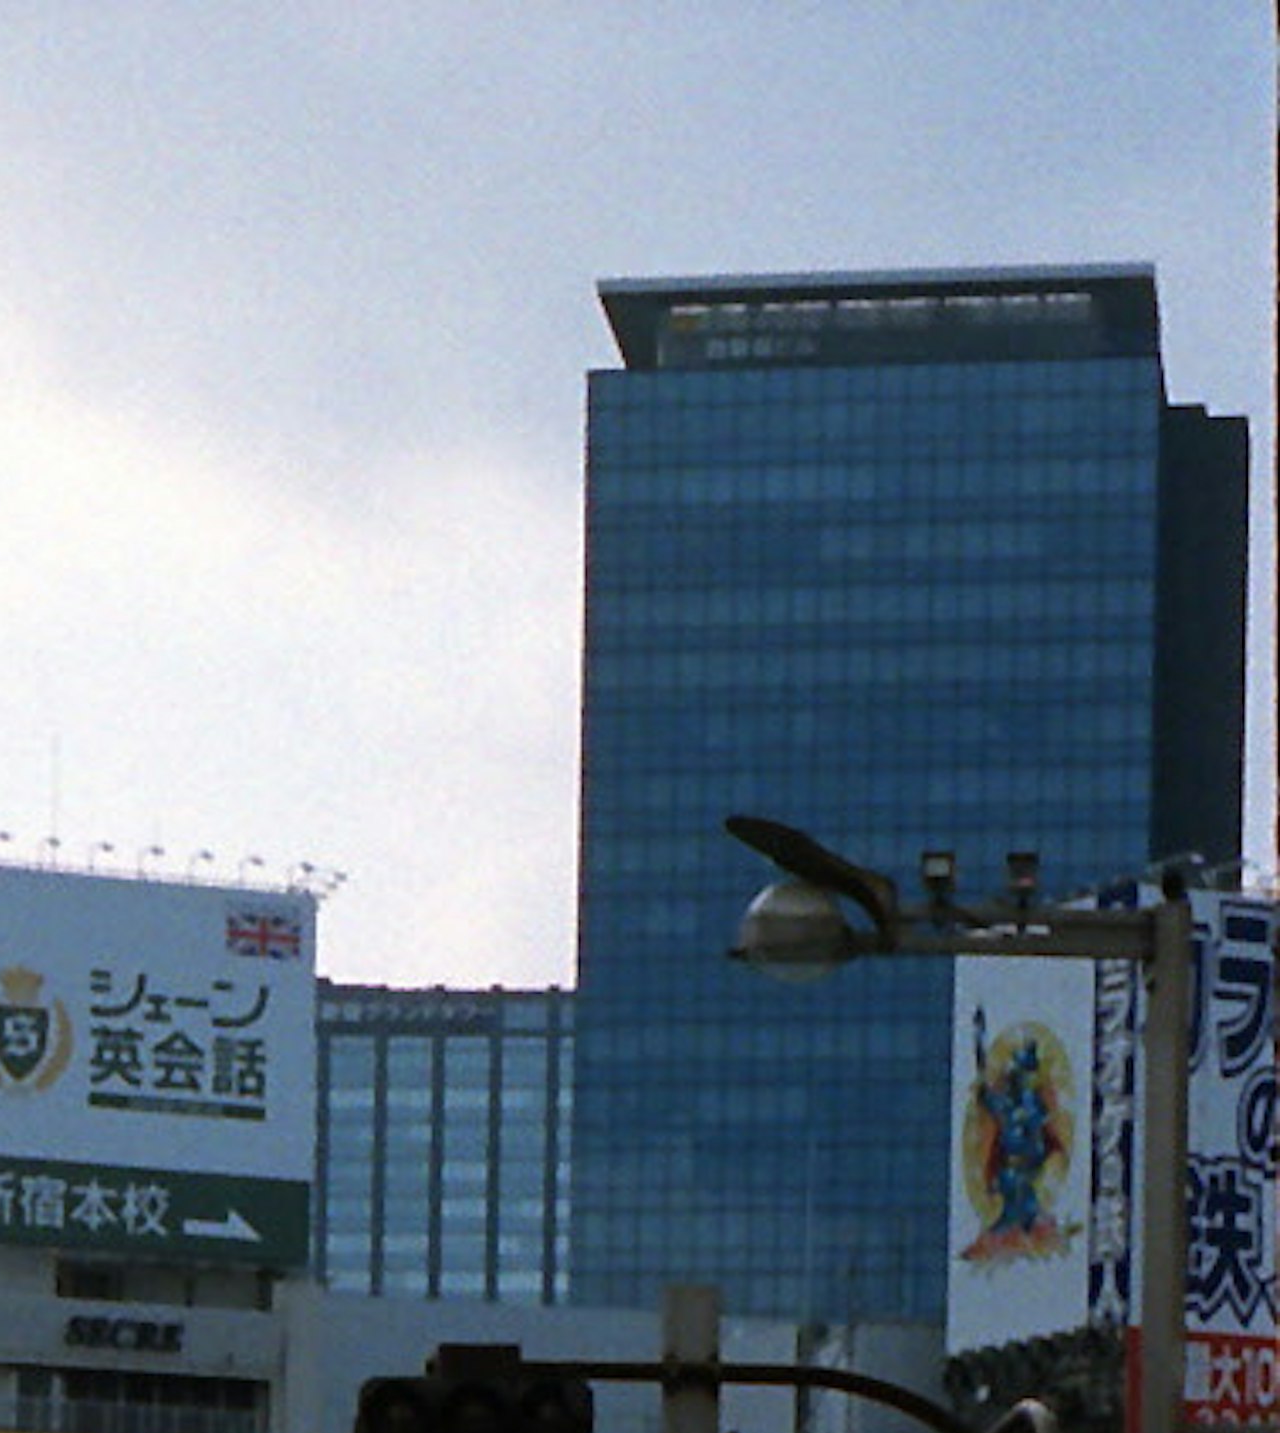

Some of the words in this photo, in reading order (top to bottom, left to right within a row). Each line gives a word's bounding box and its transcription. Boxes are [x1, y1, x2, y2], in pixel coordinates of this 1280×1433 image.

[89, 969, 270, 1028] シェーン
[88, 1027, 268, 1096] 英会話
